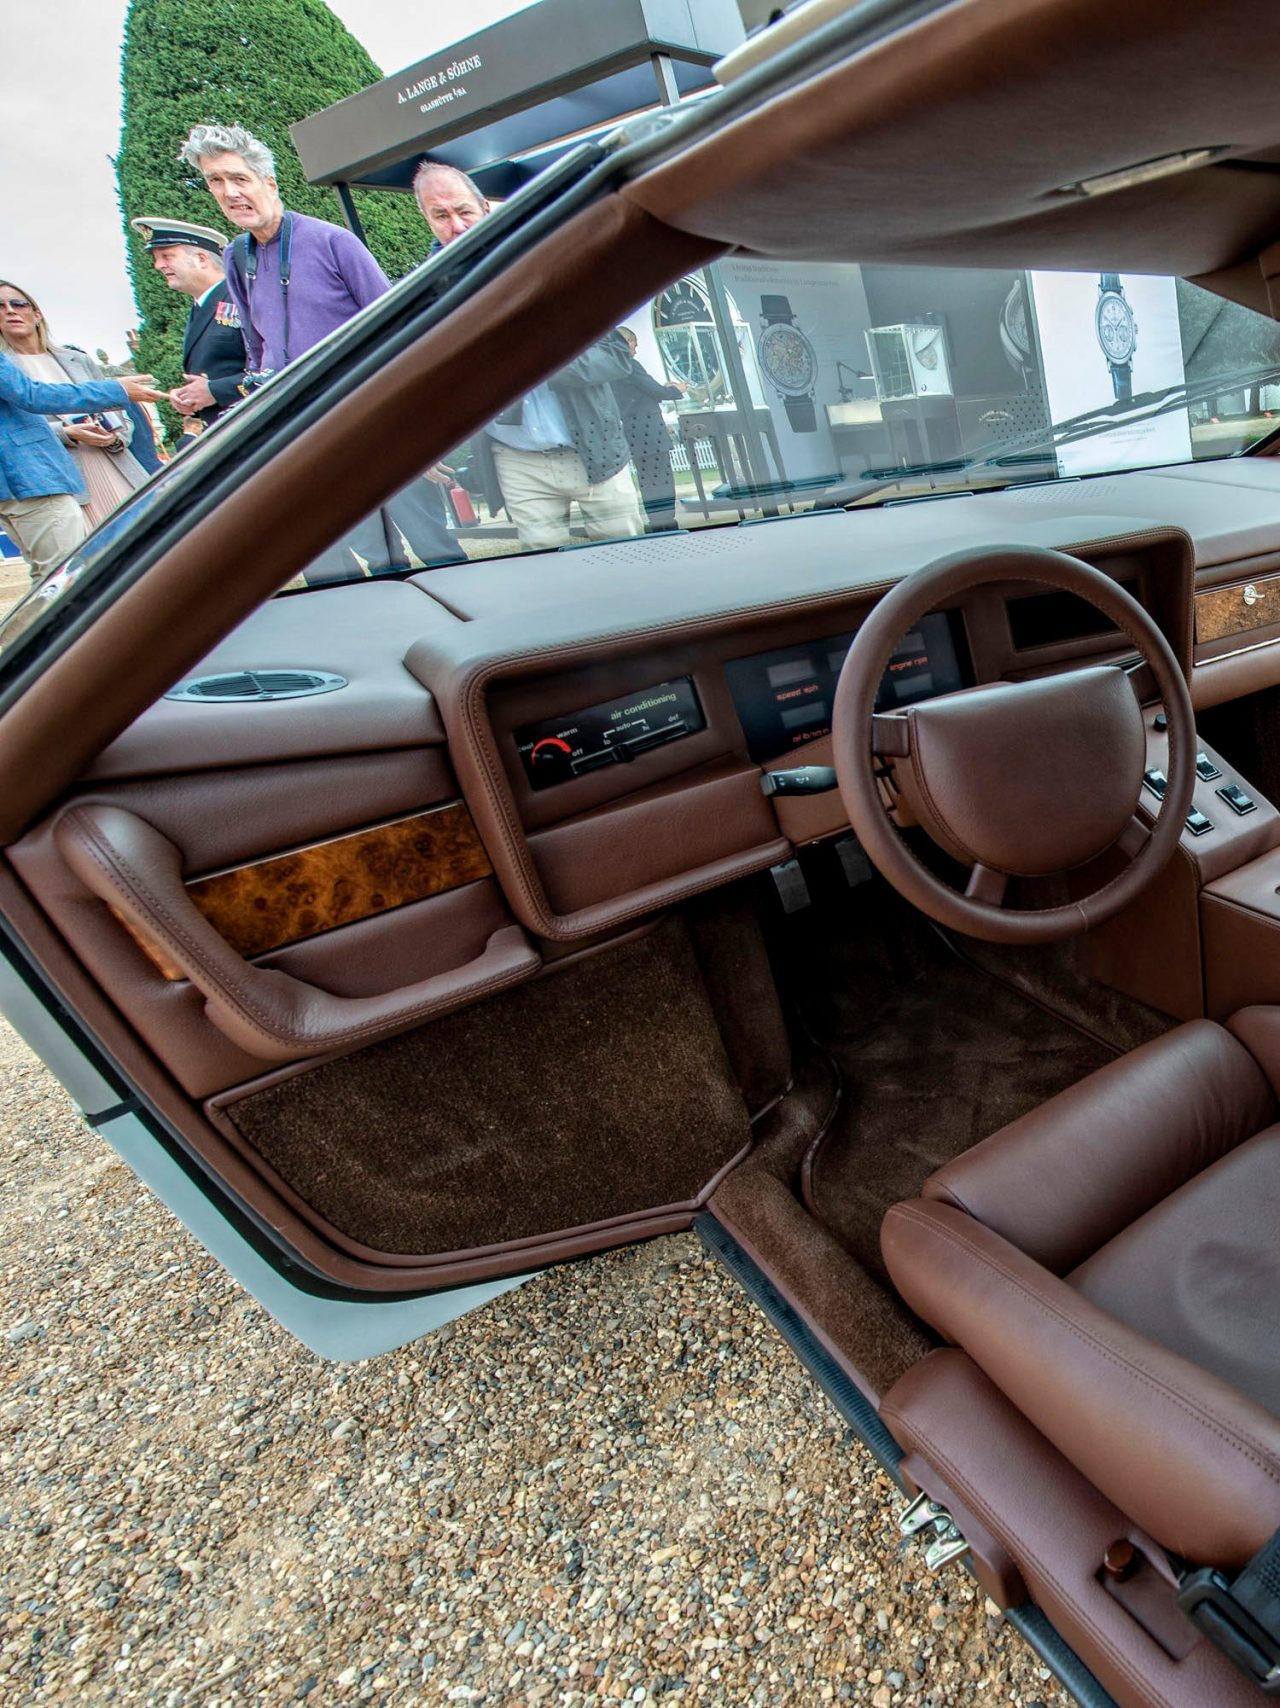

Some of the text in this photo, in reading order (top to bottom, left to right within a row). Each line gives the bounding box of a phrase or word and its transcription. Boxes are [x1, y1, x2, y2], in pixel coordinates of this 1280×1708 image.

[398, 54, 482, 104] A. LANGE & SÖHNE
[420, 92, 454, 113] GLASHÜTTE
[610, 693, 677, 720] air conditioning
[556, 728, 578, 739] warm
[616, 723, 631, 732] auto
[571, 748, 583, 757] off
